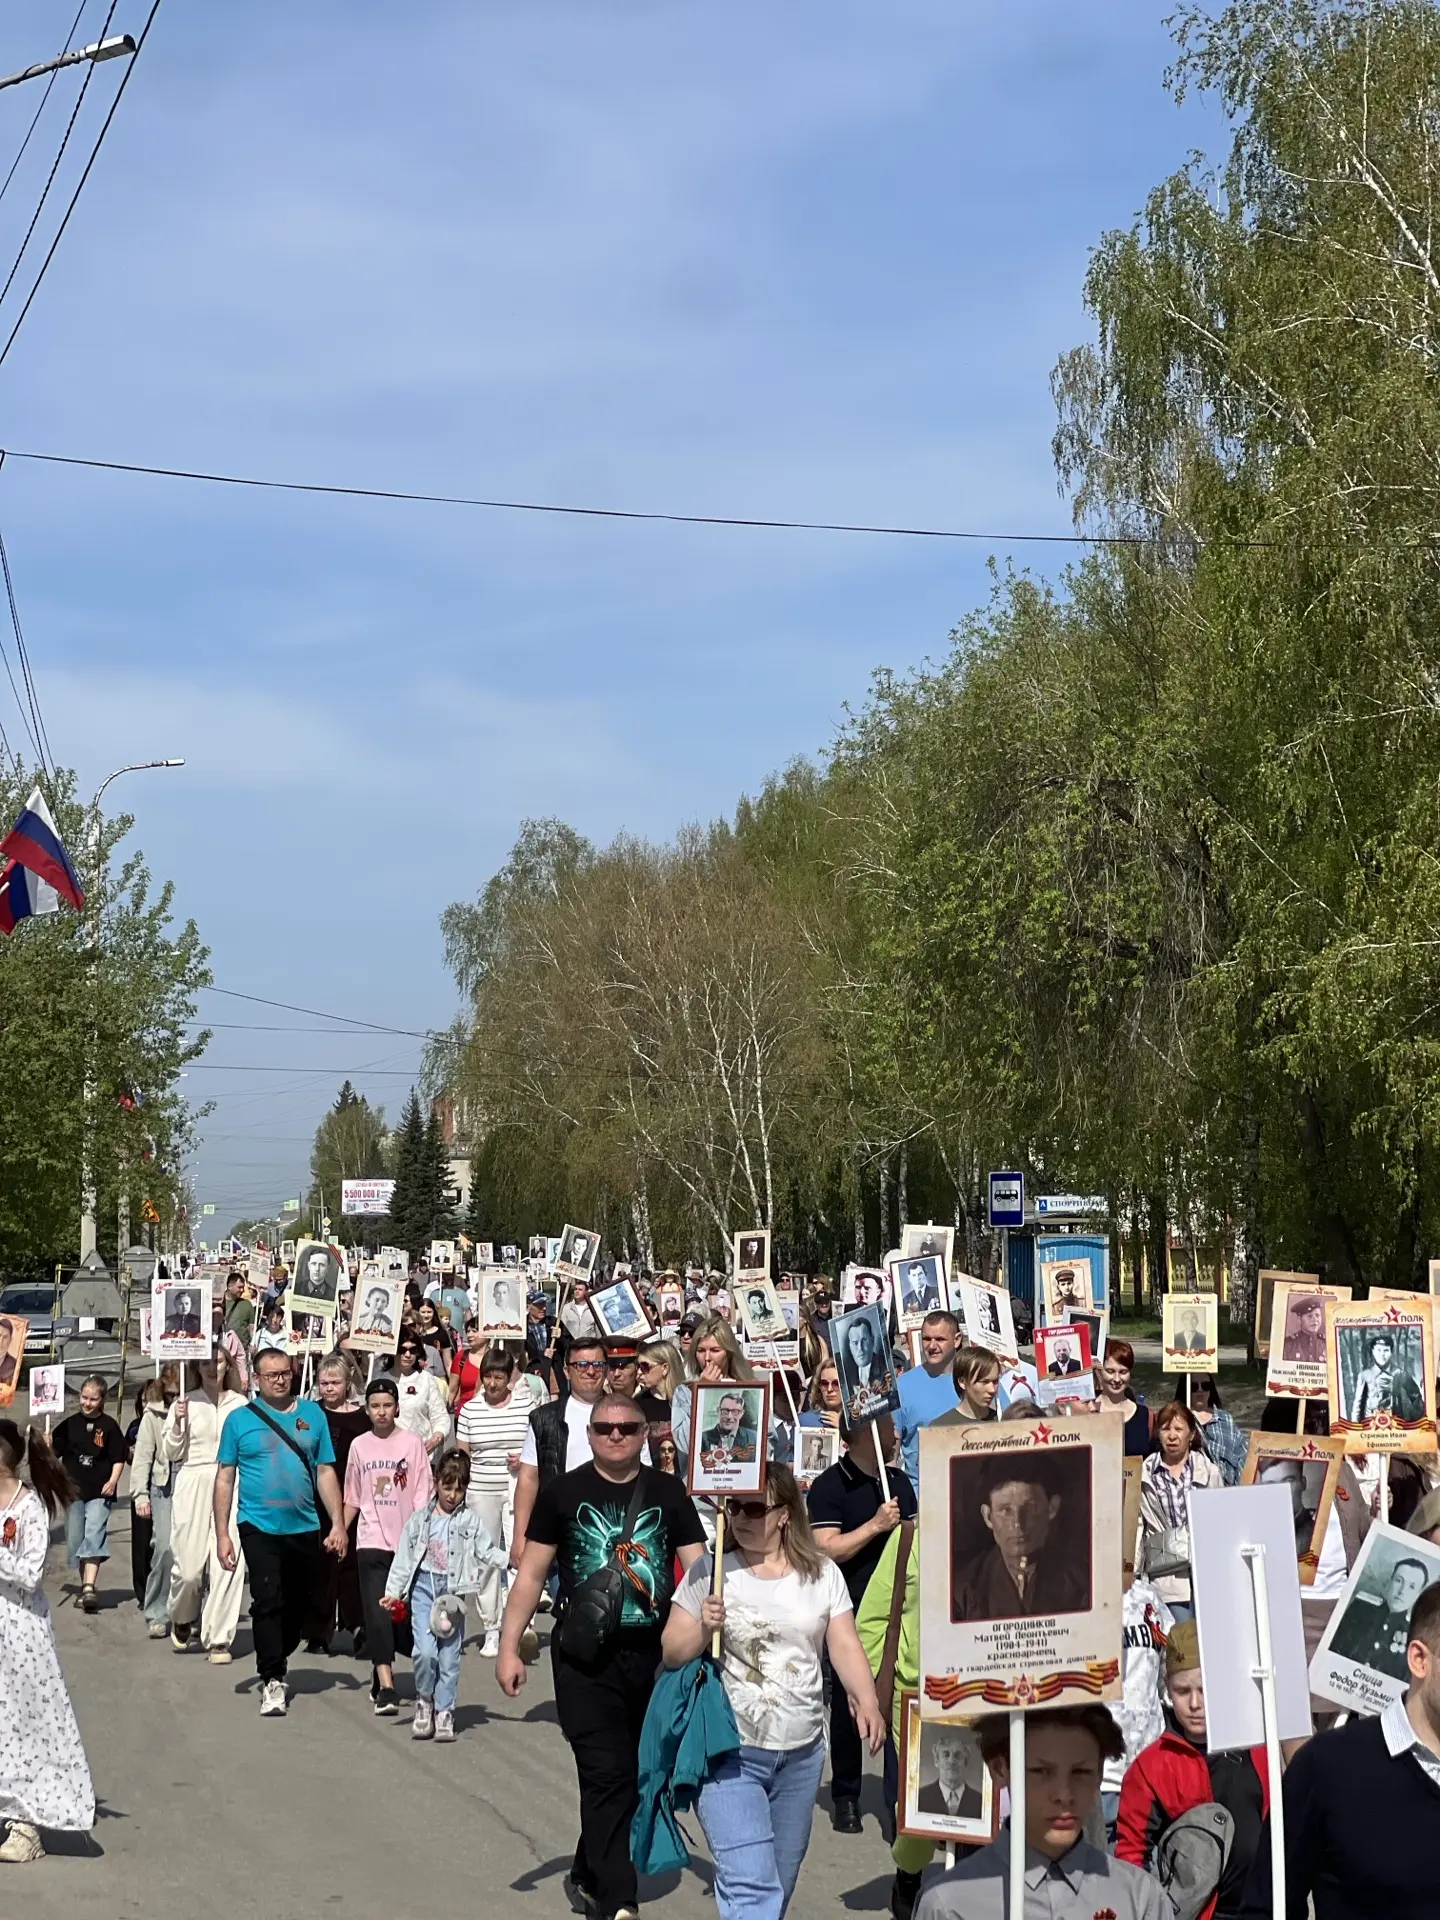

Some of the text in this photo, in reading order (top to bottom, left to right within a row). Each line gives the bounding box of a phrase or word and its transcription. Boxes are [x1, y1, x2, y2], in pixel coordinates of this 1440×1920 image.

[992, 1618, 1056, 1632] ОГОРОДНИКОВ
[974, 1628, 1069, 1643] Матвей Леонтьевич
[987, 1648, 1056, 1661] красноармеец
[966, 1662, 1016, 1672] гвардейская
[1019, 1659, 1063, 1669] стрелковая
[1067, 1654, 1097, 1664] дивизия
[1330, 1671, 1358, 1691] Федор
[1352, 1668, 1383, 1688] Спица
